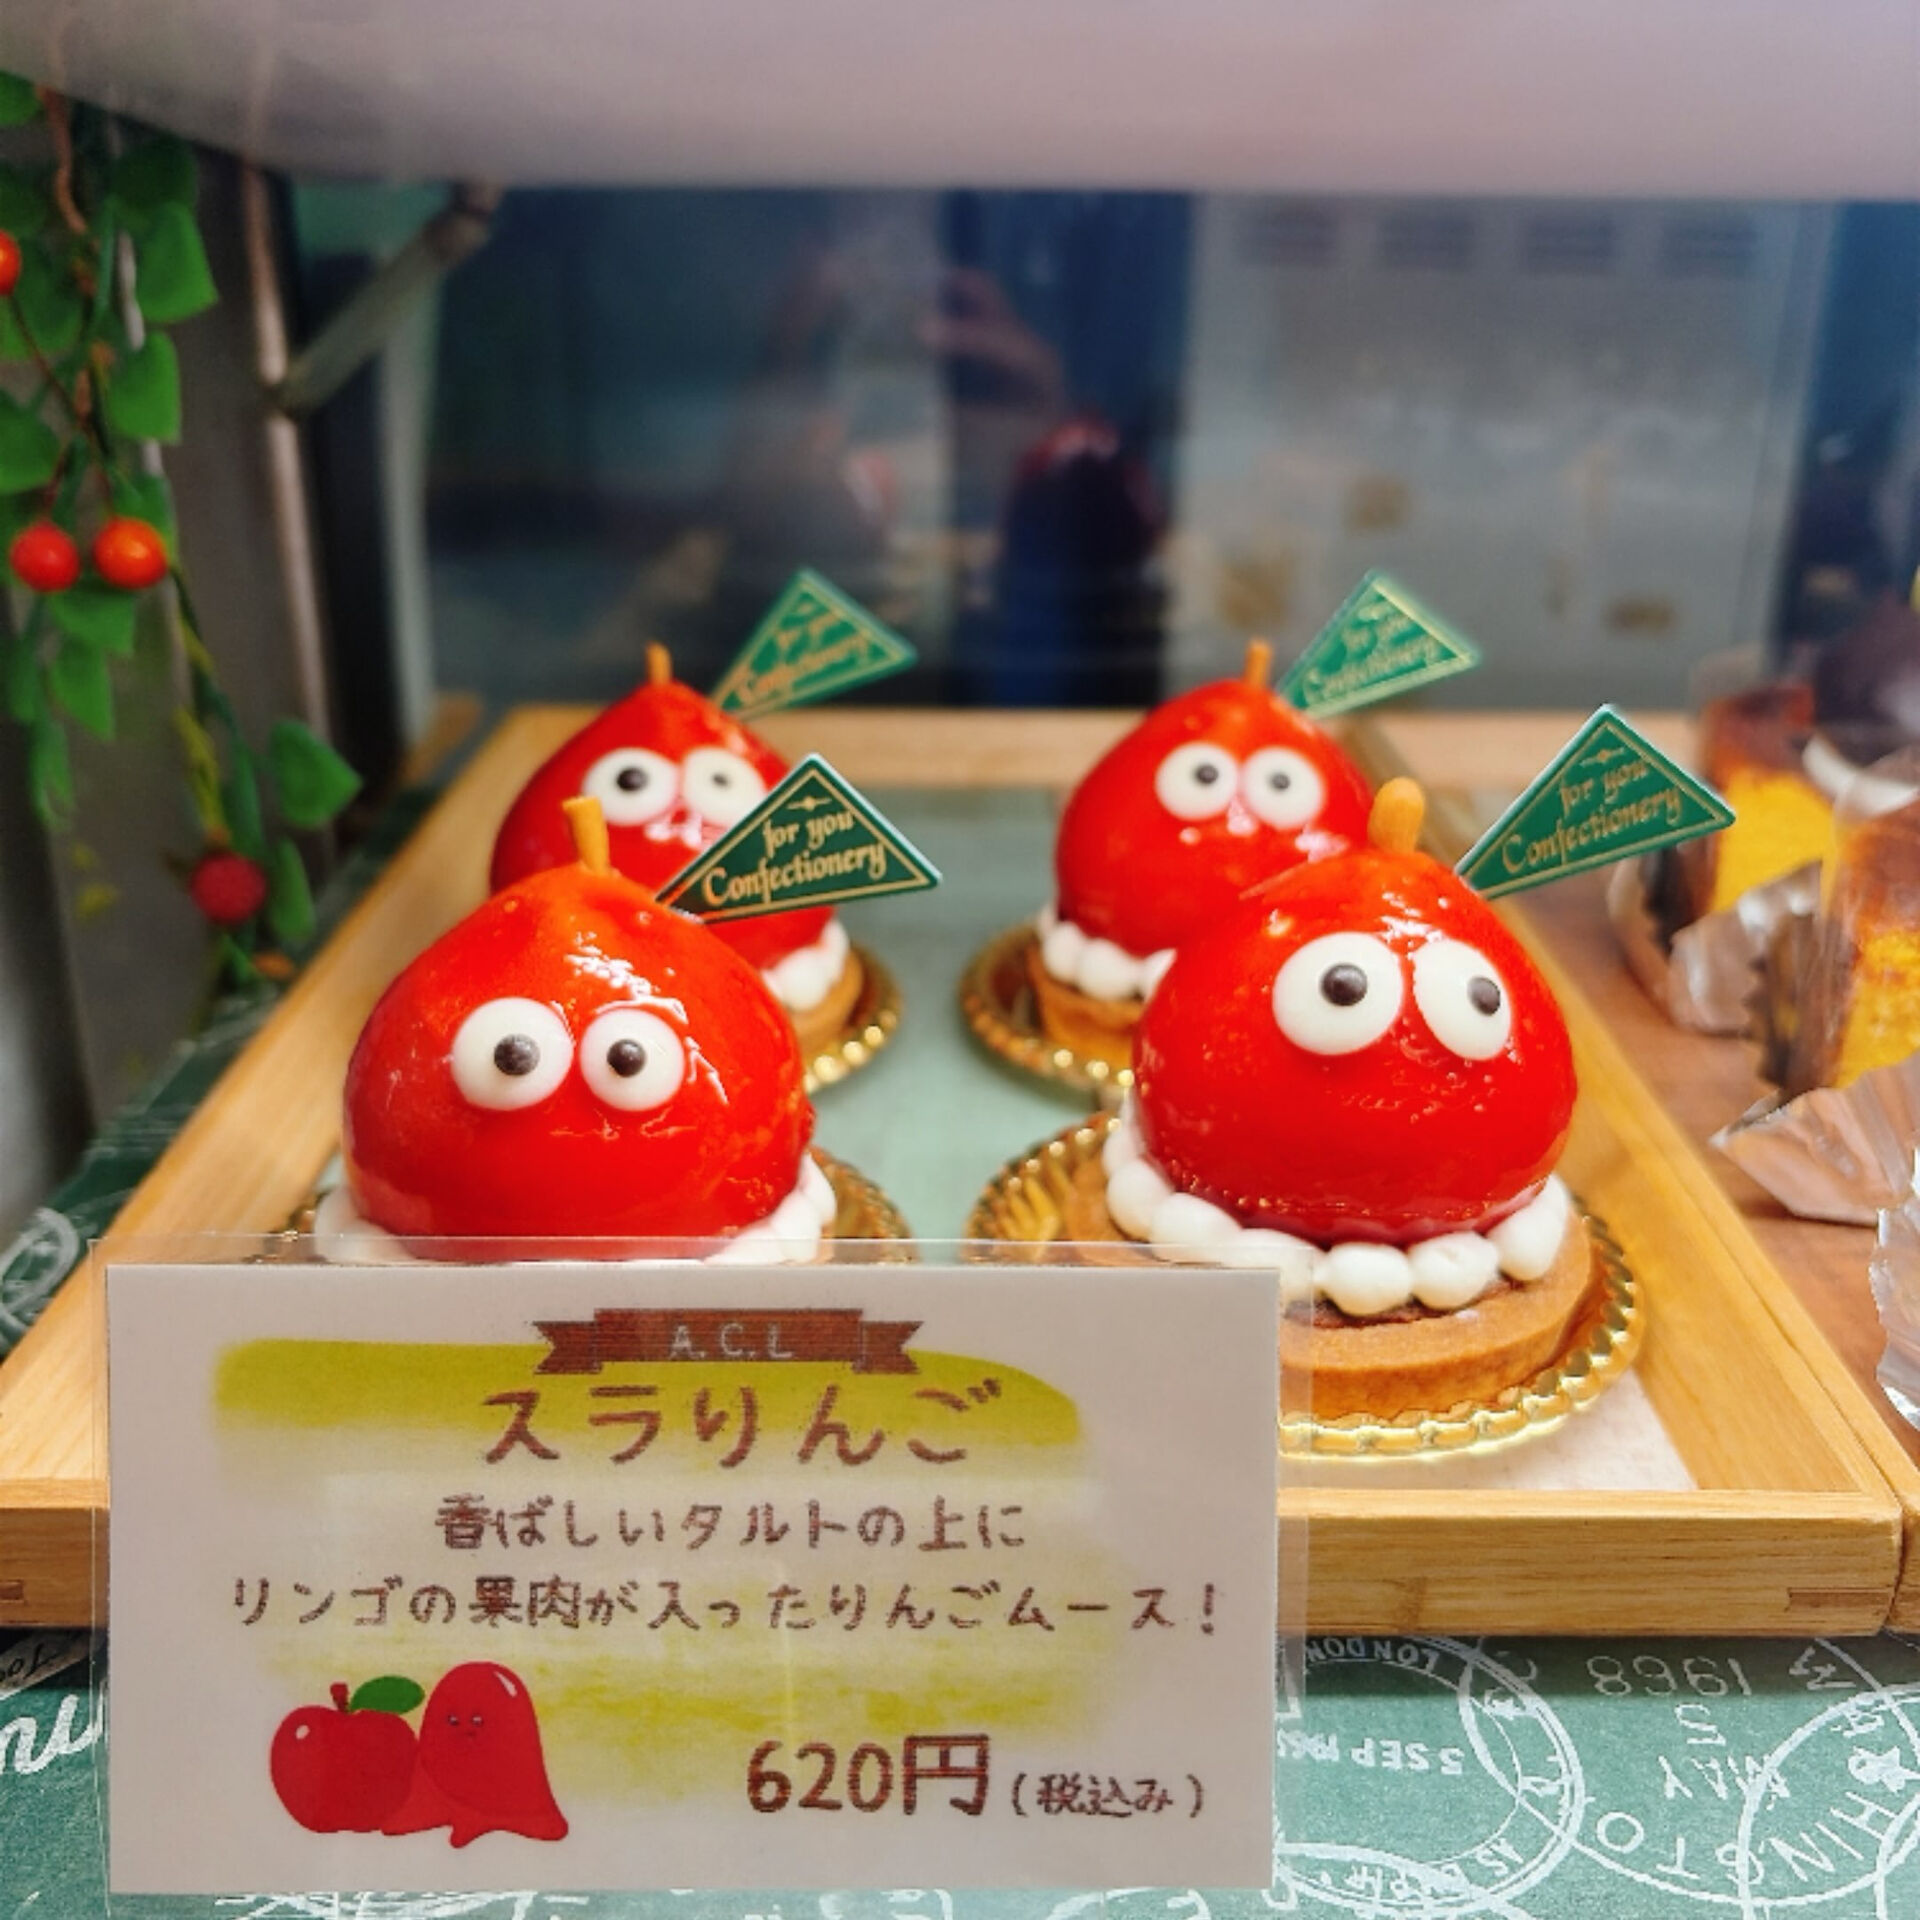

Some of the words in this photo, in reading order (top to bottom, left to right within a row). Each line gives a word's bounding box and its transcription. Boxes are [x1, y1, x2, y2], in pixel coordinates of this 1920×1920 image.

[762, 818, 801, 859] for
[805, 810, 856, 850] you
[1502, 785, 1682, 874] Confectionery
[702, 839, 888, 908] Confectionery
[482, 1377, 1002, 1469] スラりんご
[434, 1493, 1025, 1553] 香ばしいタルトの上に
[1585, 1655, 1754, 1698] 1968
[746, 1733, 990, 1818] 620円
[1351, 1737, 1431, 1772] SEP
